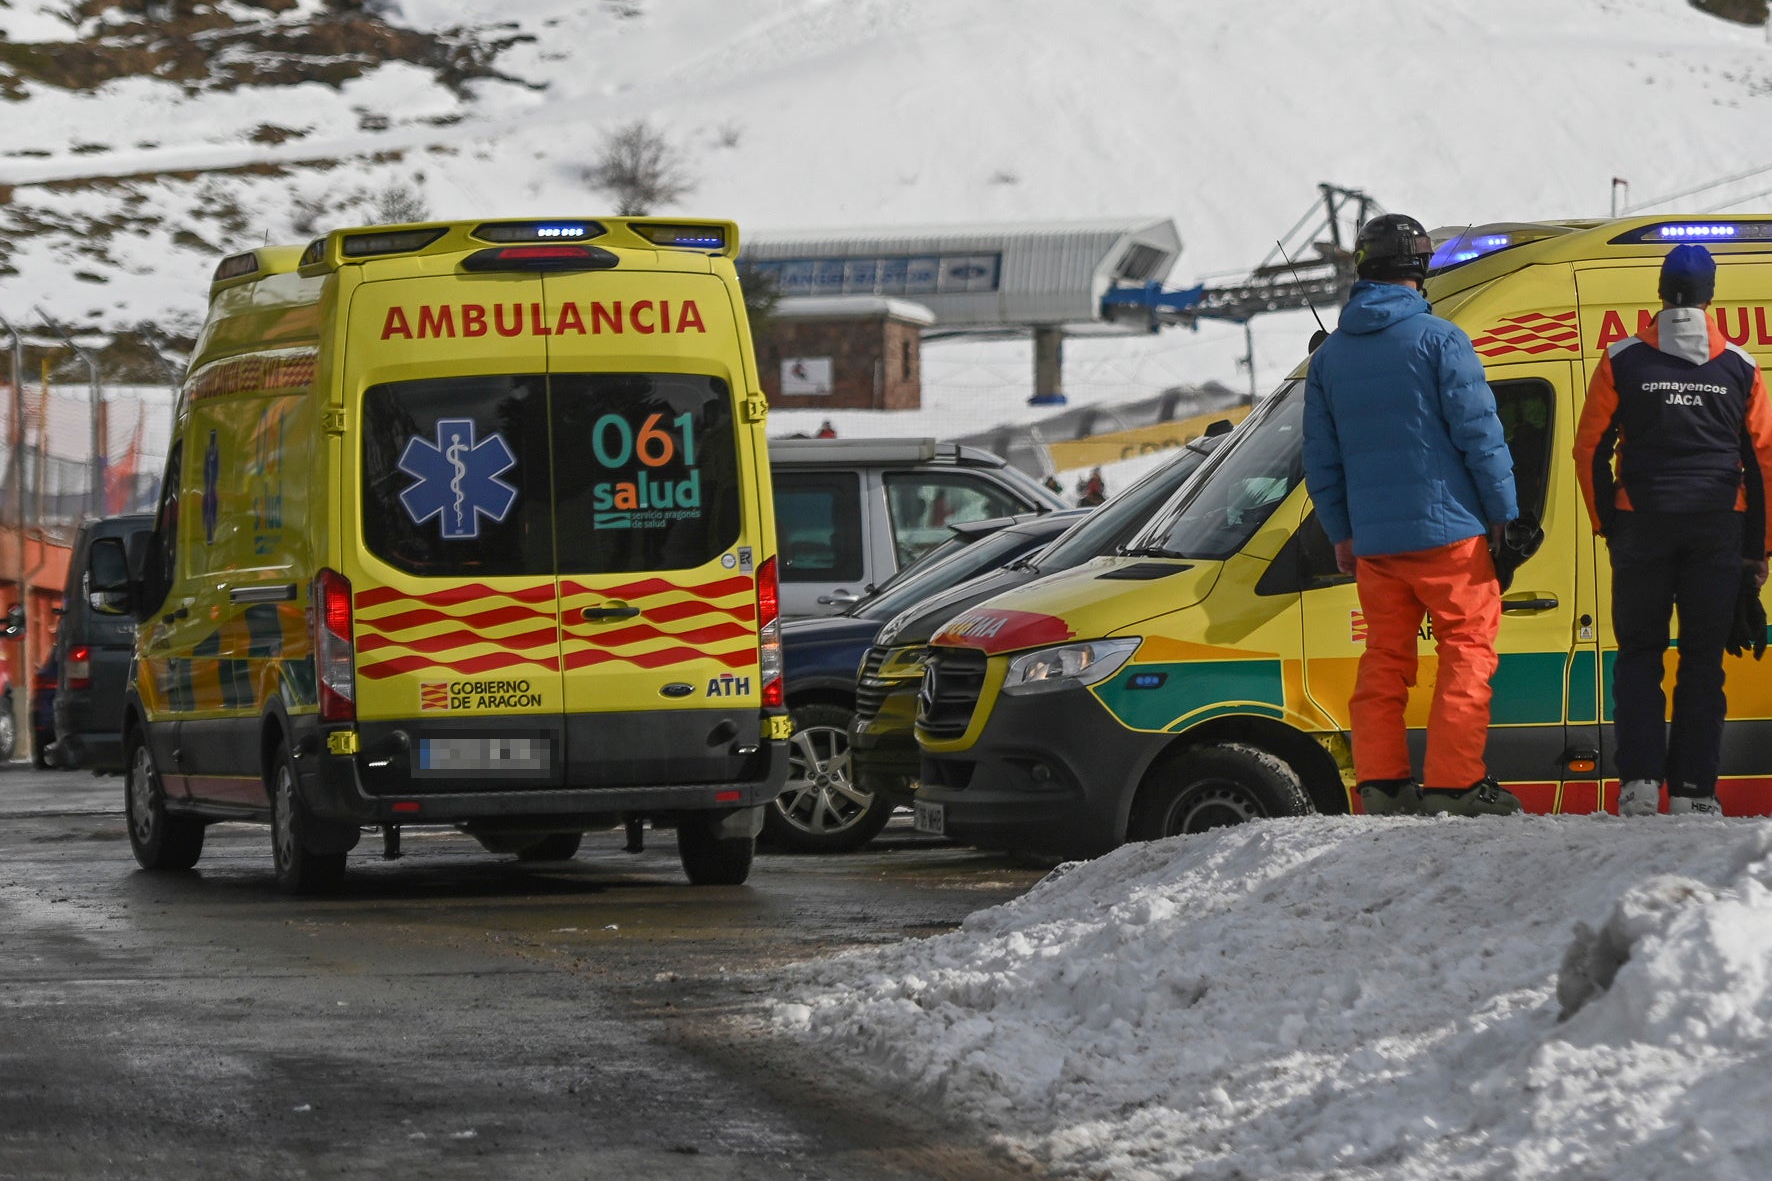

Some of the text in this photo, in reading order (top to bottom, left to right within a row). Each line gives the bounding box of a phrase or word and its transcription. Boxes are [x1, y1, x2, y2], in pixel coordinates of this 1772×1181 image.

[380, 300, 707, 340] AMBULANCIA
[1642, 381, 1728, 395] cpmayencos
[1665, 394, 1703, 406] JACA
[592, 412, 694, 469] 061
[593, 469, 700, 511] salud
[631, 509, 700, 520] servicio aragonés
[631, 520, 666, 529] de salud
[450, 680, 530, 695] GOBIERNO
[706, 677, 750, 697] ATH
[450, 694, 541, 709] DE ARAGON
